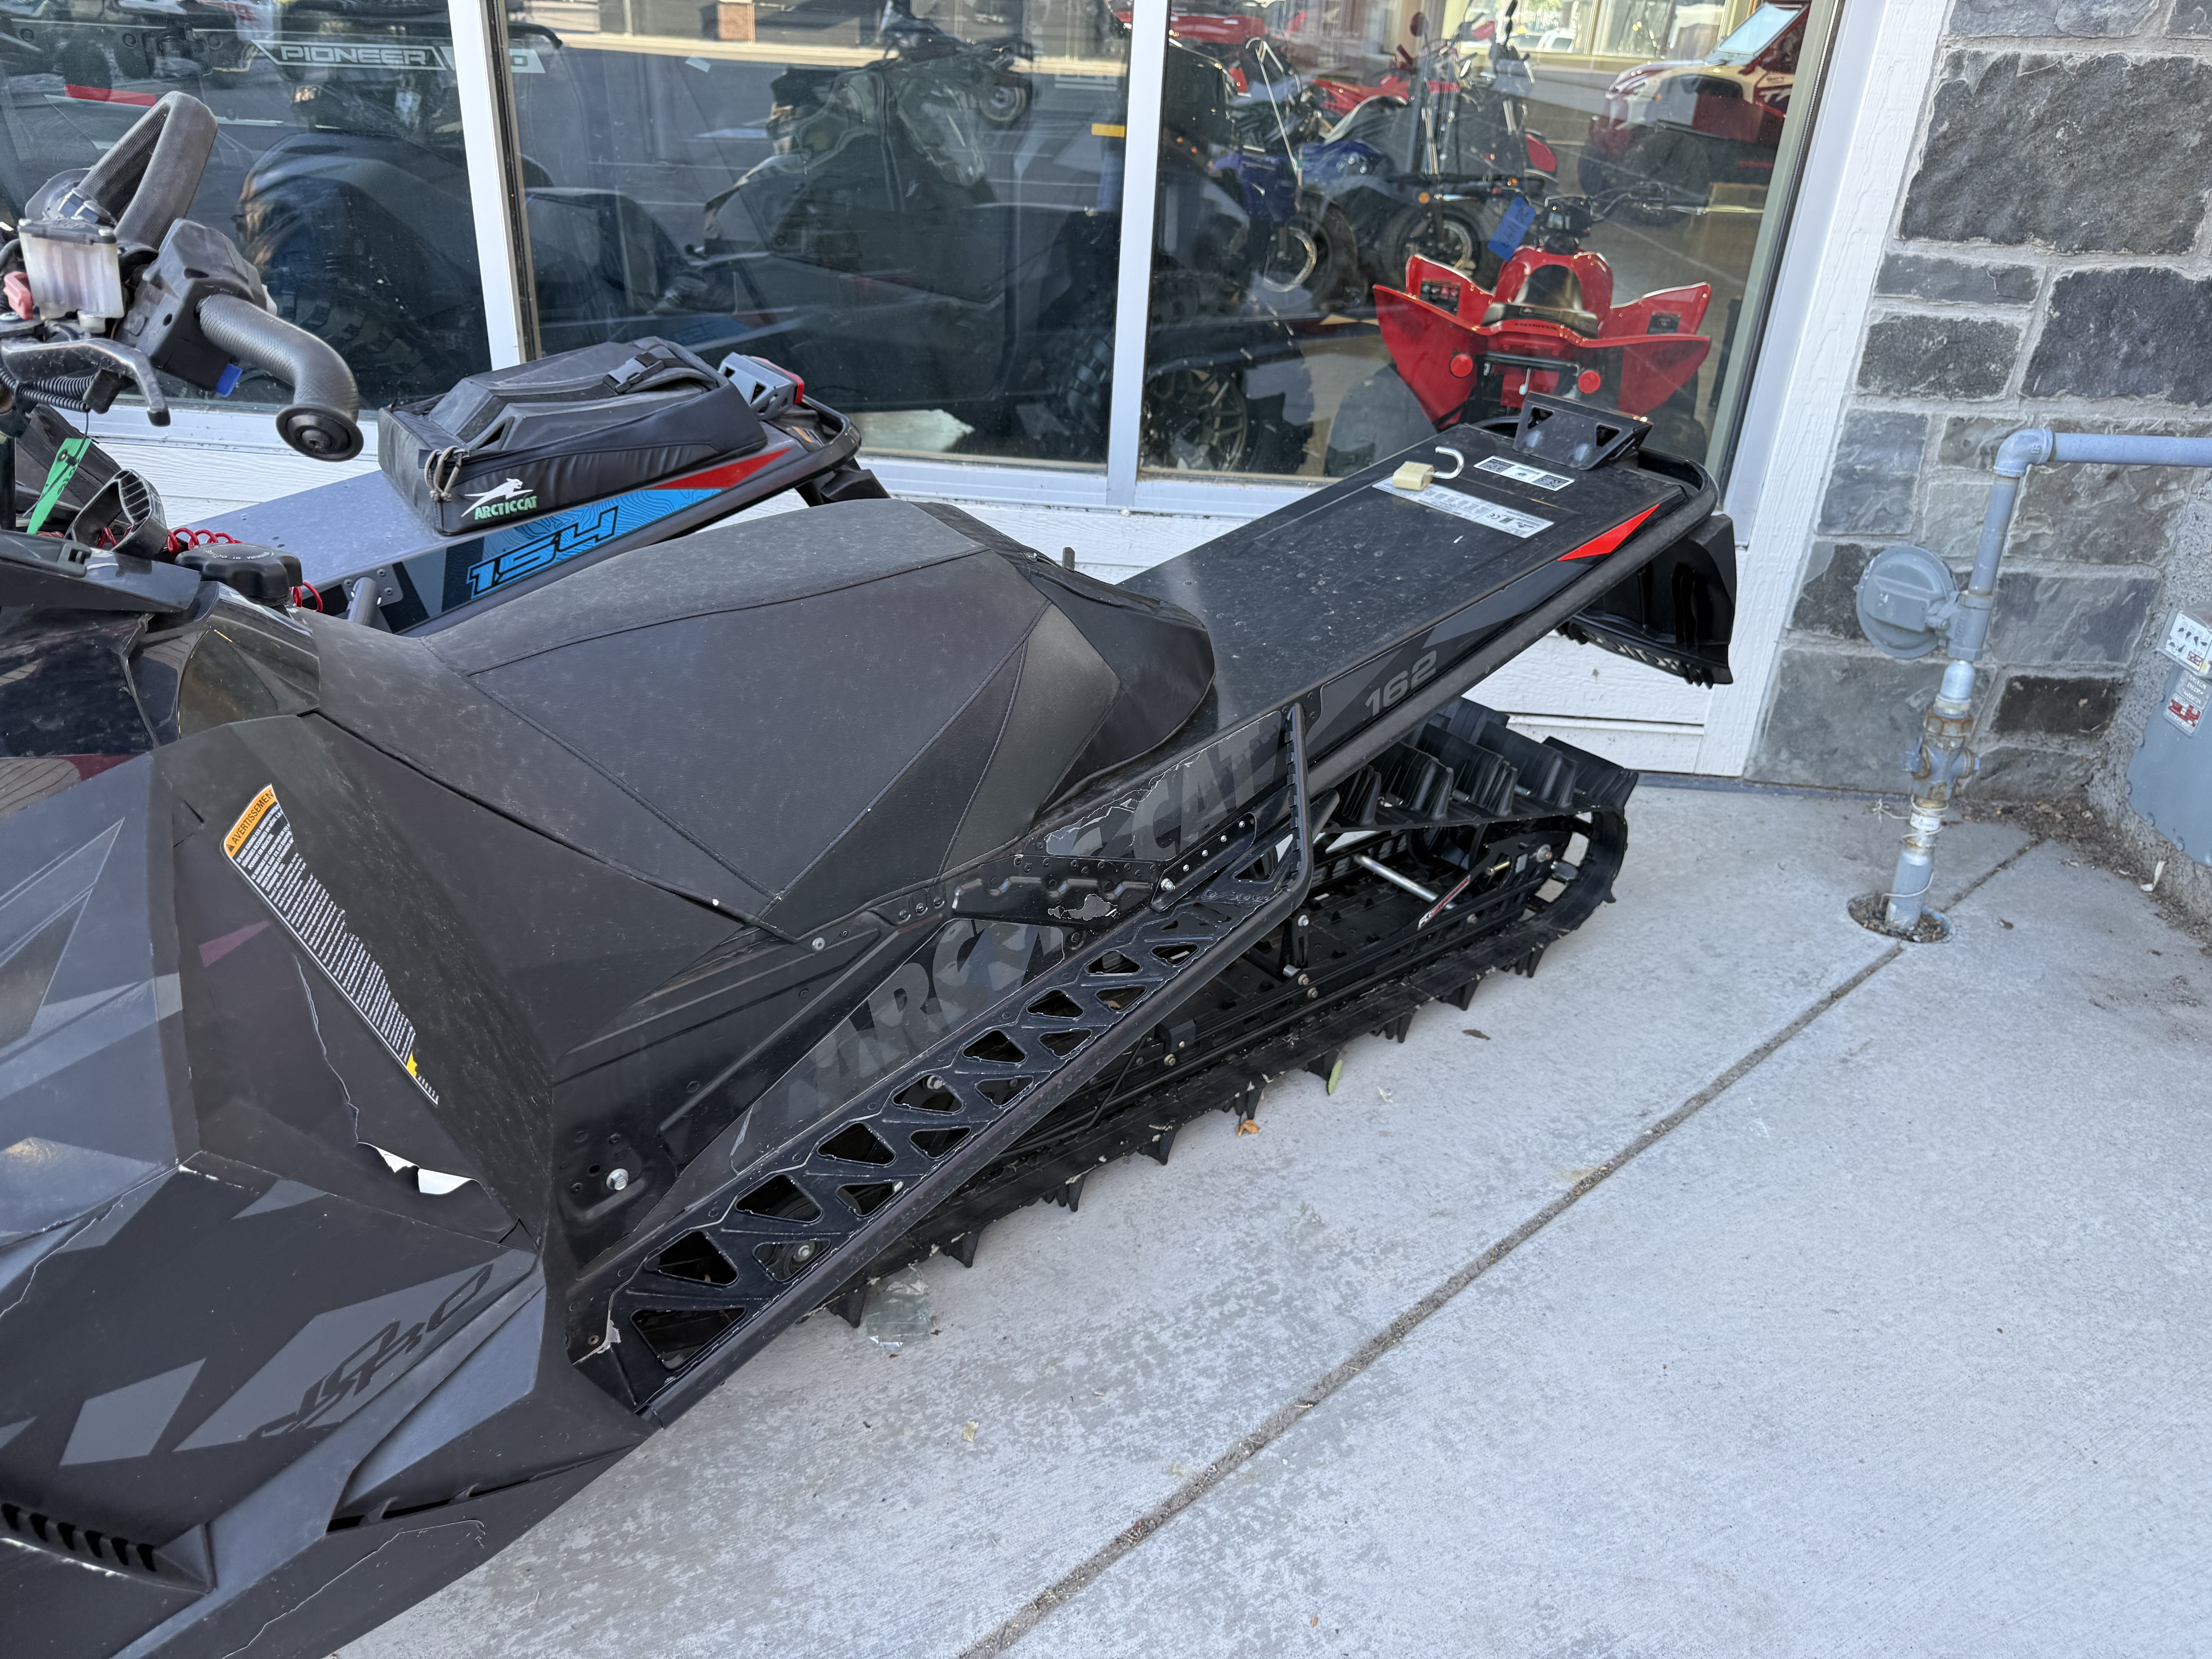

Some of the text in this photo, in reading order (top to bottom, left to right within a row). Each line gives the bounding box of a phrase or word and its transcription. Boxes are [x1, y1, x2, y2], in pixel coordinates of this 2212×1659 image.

[280, 45, 428, 65] PIONEER
[468, 505, 619, 597] 154
[1365, 650, 1437, 717] 162
